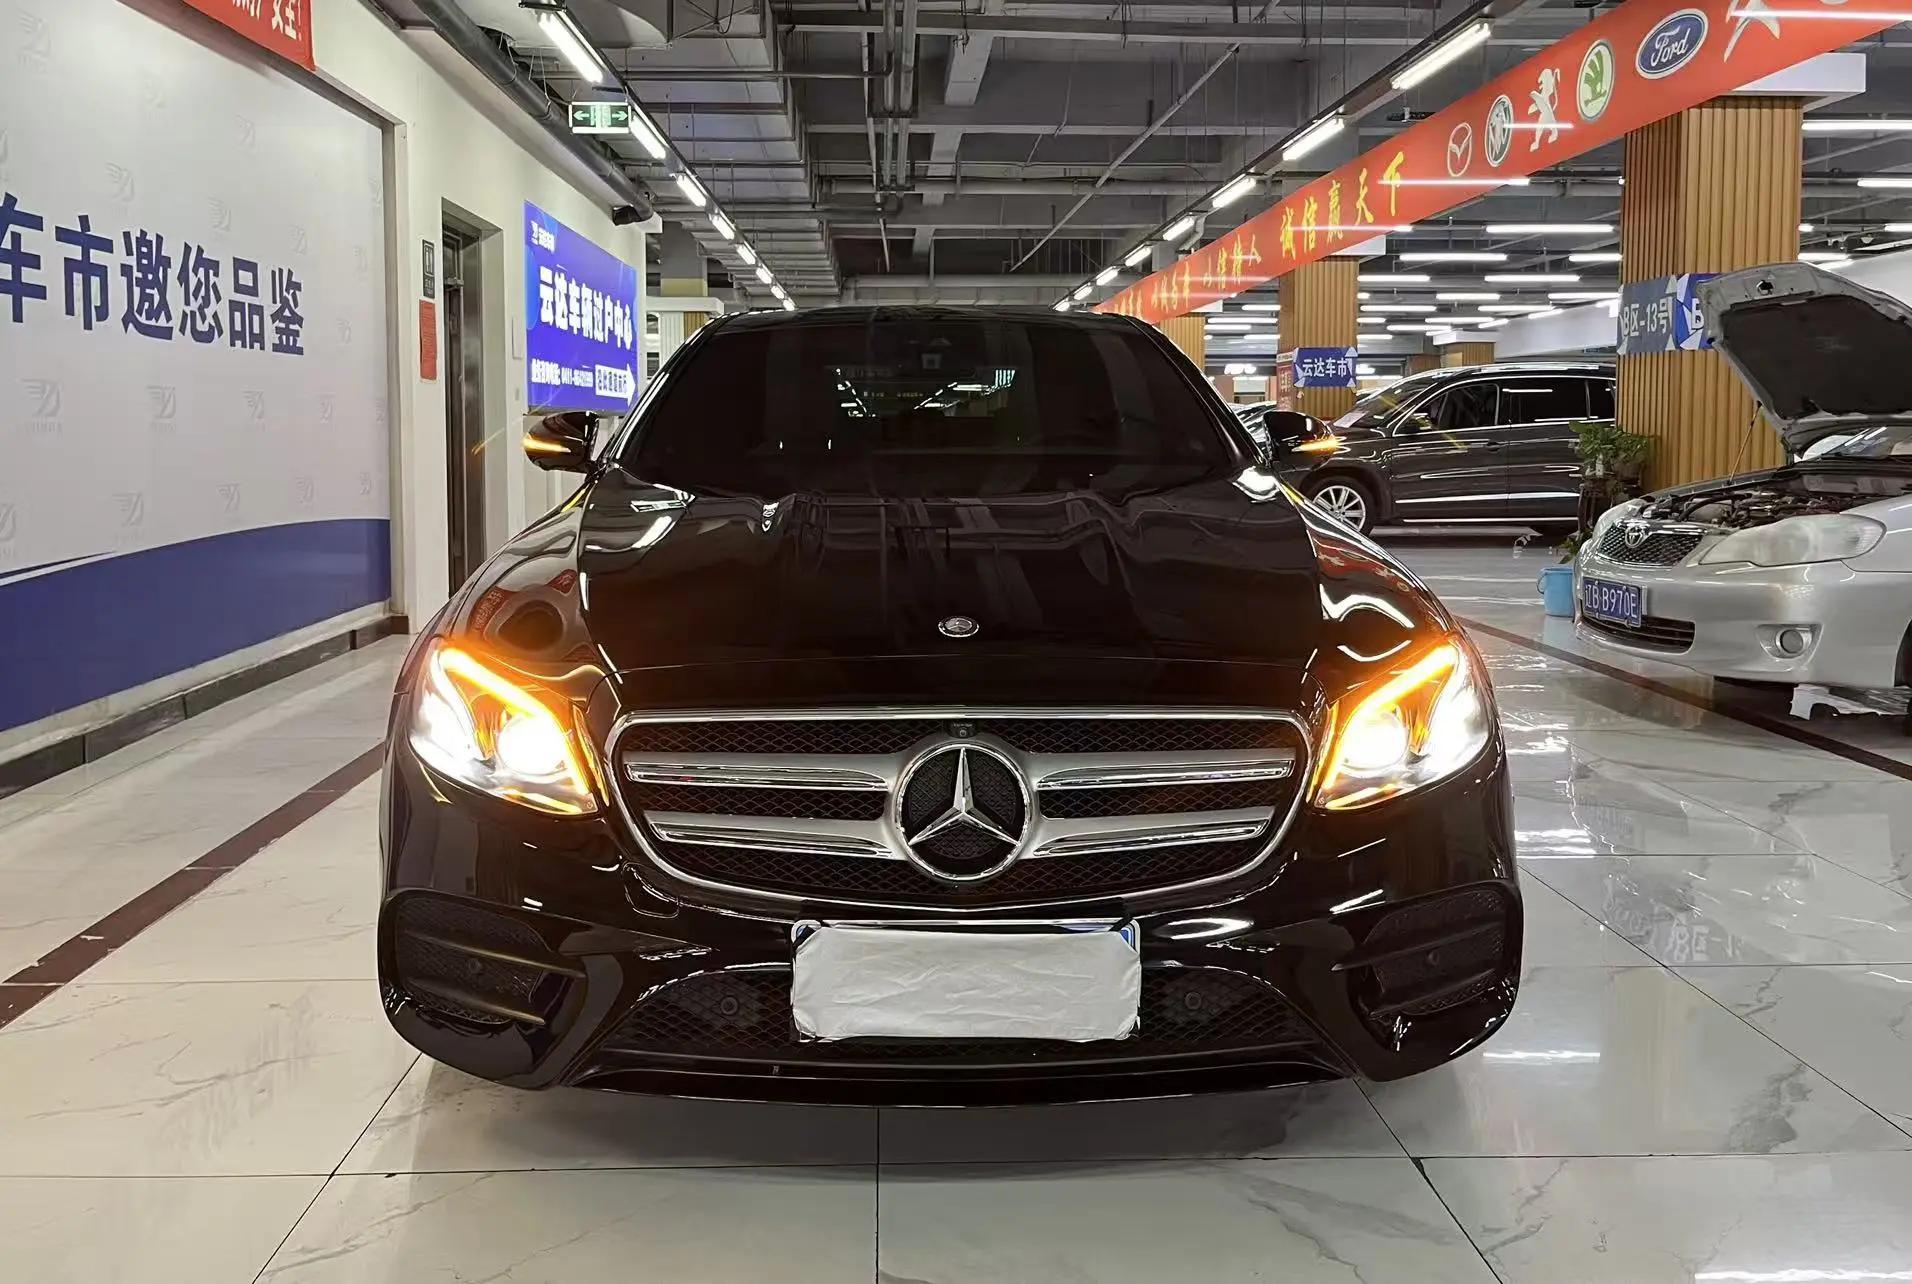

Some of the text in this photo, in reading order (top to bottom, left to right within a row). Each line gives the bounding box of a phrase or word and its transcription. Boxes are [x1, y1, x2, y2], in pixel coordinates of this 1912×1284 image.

[1650, 25, 1690, 67] Ford
[0, 191, 305, 356] 车市邀您品鉴
[1623, 296, 1669, 338] B区-13号
[1302, 356, 1349, 378] 云达车市
